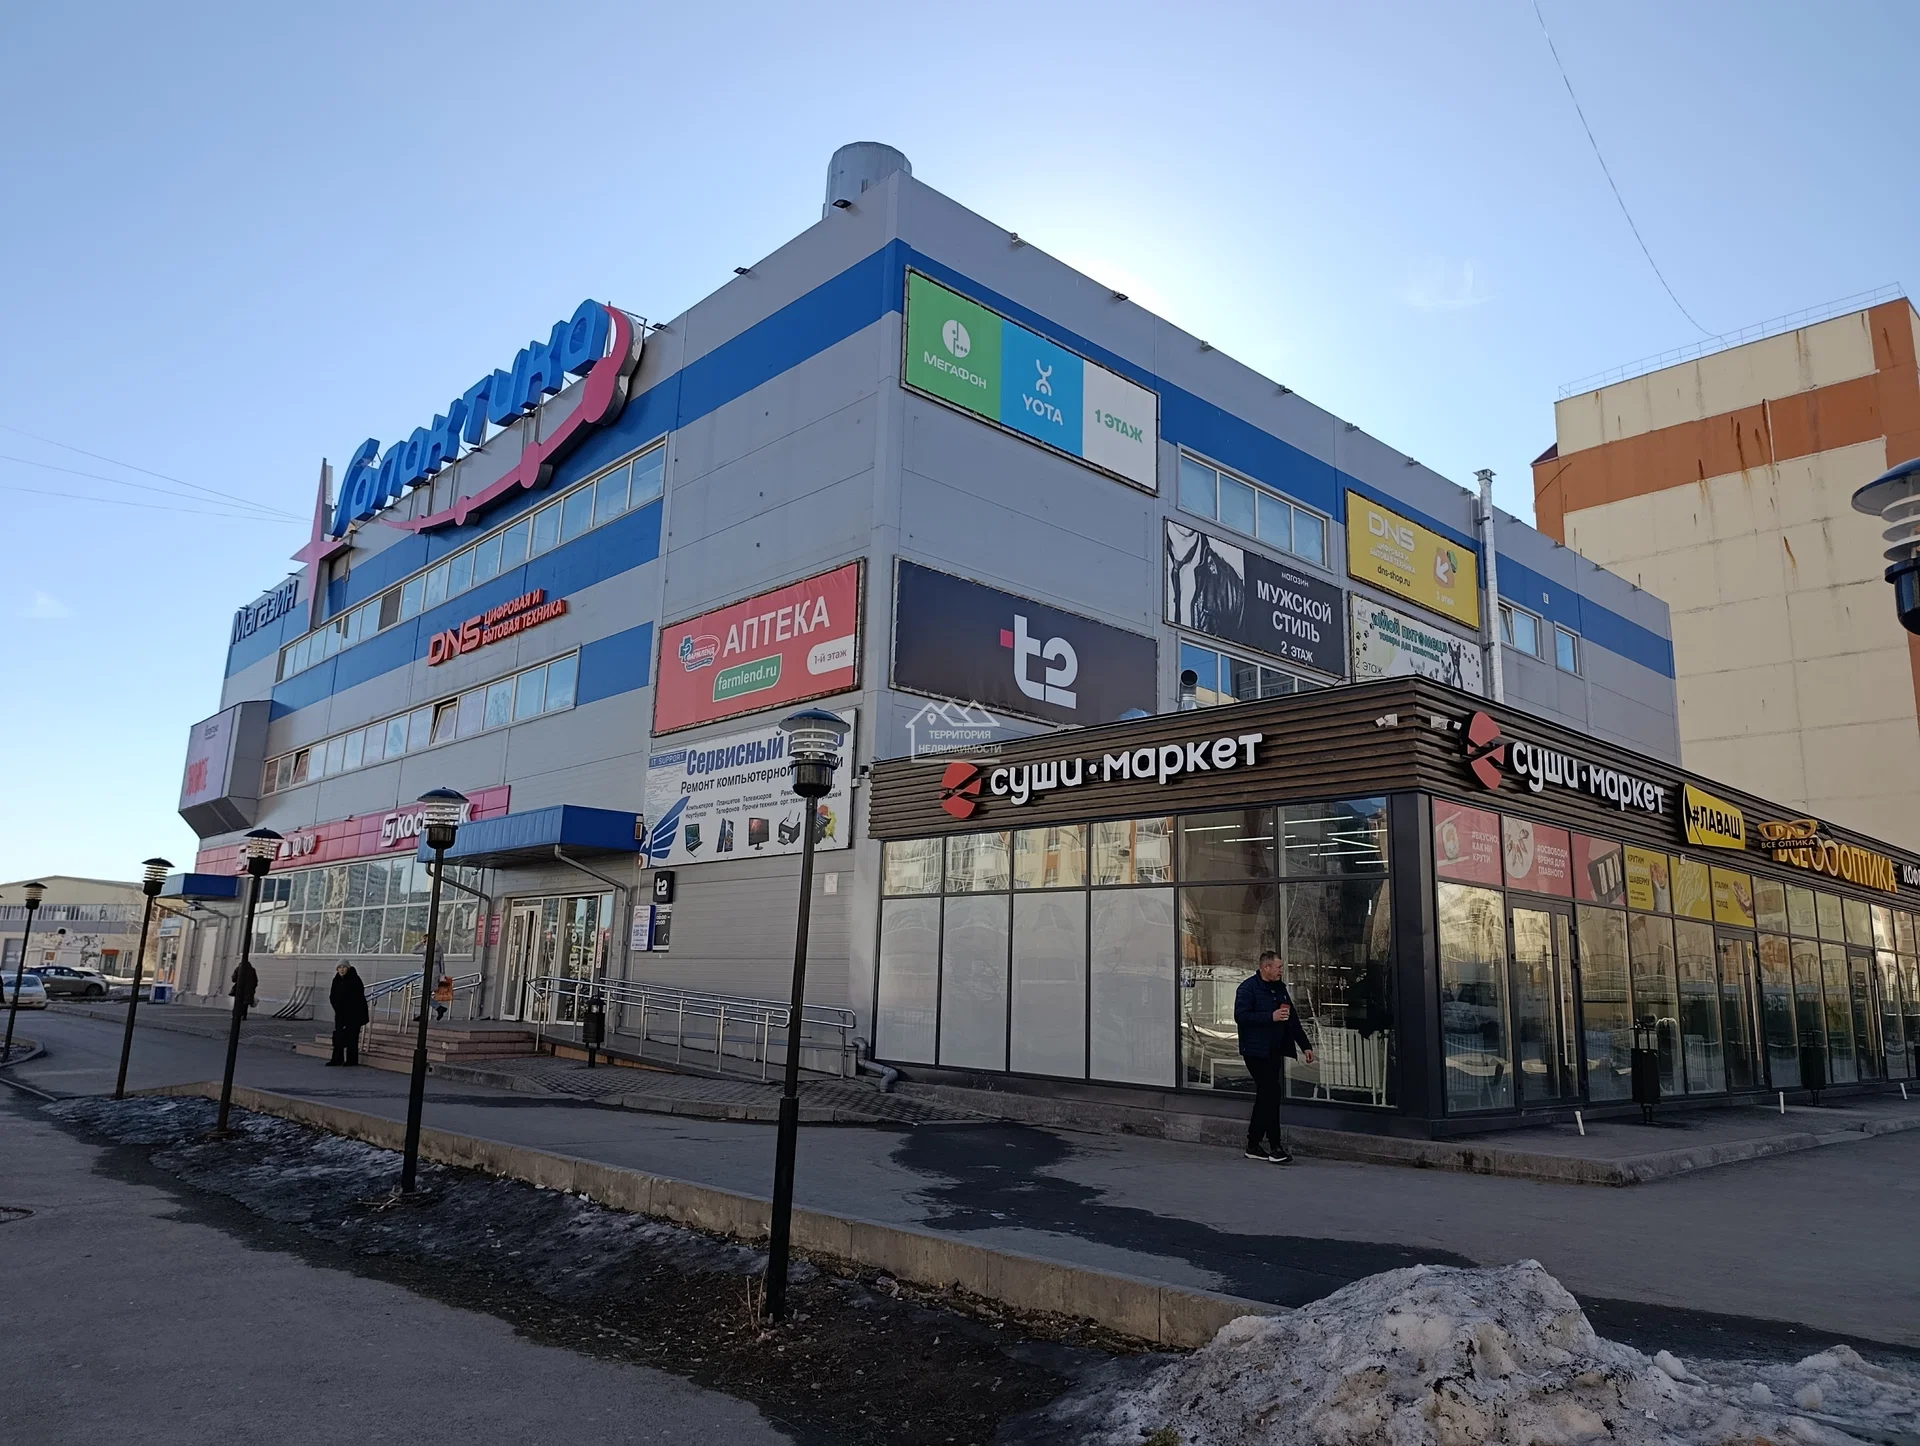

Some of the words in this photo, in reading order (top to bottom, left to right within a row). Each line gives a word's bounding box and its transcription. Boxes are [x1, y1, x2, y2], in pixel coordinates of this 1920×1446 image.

[1022, 393, 1063, 426] YOTA
[1095, 409, 1102, 423] 1
[1104, 413, 1143, 443] ЭТАЖ
[1368, 510, 1415, 552] DNS
[1281, 571, 1309, 588] магазин
[1378, 565, 1411, 587] dns-shop.ru
[233, 580, 298, 645] Магазин
[484, 592, 531, 625] ЦИФРОВАЯ
[532, 588, 544, 604] И
[1257, 579, 1333, 625] МУЖСКОЙ
[482, 617, 520, 644] БЫТОВАЯ
[521, 598, 567, 626] ТЕХНИКА
[722, 595, 831, 658] АПТЕКА
[1272, 610, 1321, 643] СТИЛЬ
[428, 615, 482, 666] DNS
[814, 653, 826, 665] 1-й
[827, 649, 848, 662] этаж
[1281, 641, 1288, 655] 2
[1290, 646, 1314, 663] ЭТАЖ
[718, 665, 777, 691] farmlend.ru
[1001, 613, 1079, 710] t2
[659, 752, 685, 765] SUPPORT
[687, 730, 784, 776] Сервисный
[681, 778, 714, 794] Ремонт
[716, 766, 794, 788] компьютерной
[1692, 805, 1742, 840] #ЛАВАШ
[1472, 853, 1491, 863] КРУТИ
[1761, 840, 1776, 848] ВСЕ
[1778, 839, 1815, 848] ОПТИКА
[1537, 855, 1554, 866] ВРЕМЯ
[1554, 858, 1566, 868] ДЛЯ
[1538, 866, 1564, 878] ГЛАВНОГО
[1840, 843, 1898, 894] ОПТИКА
[656, 877, 668, 896] t2
